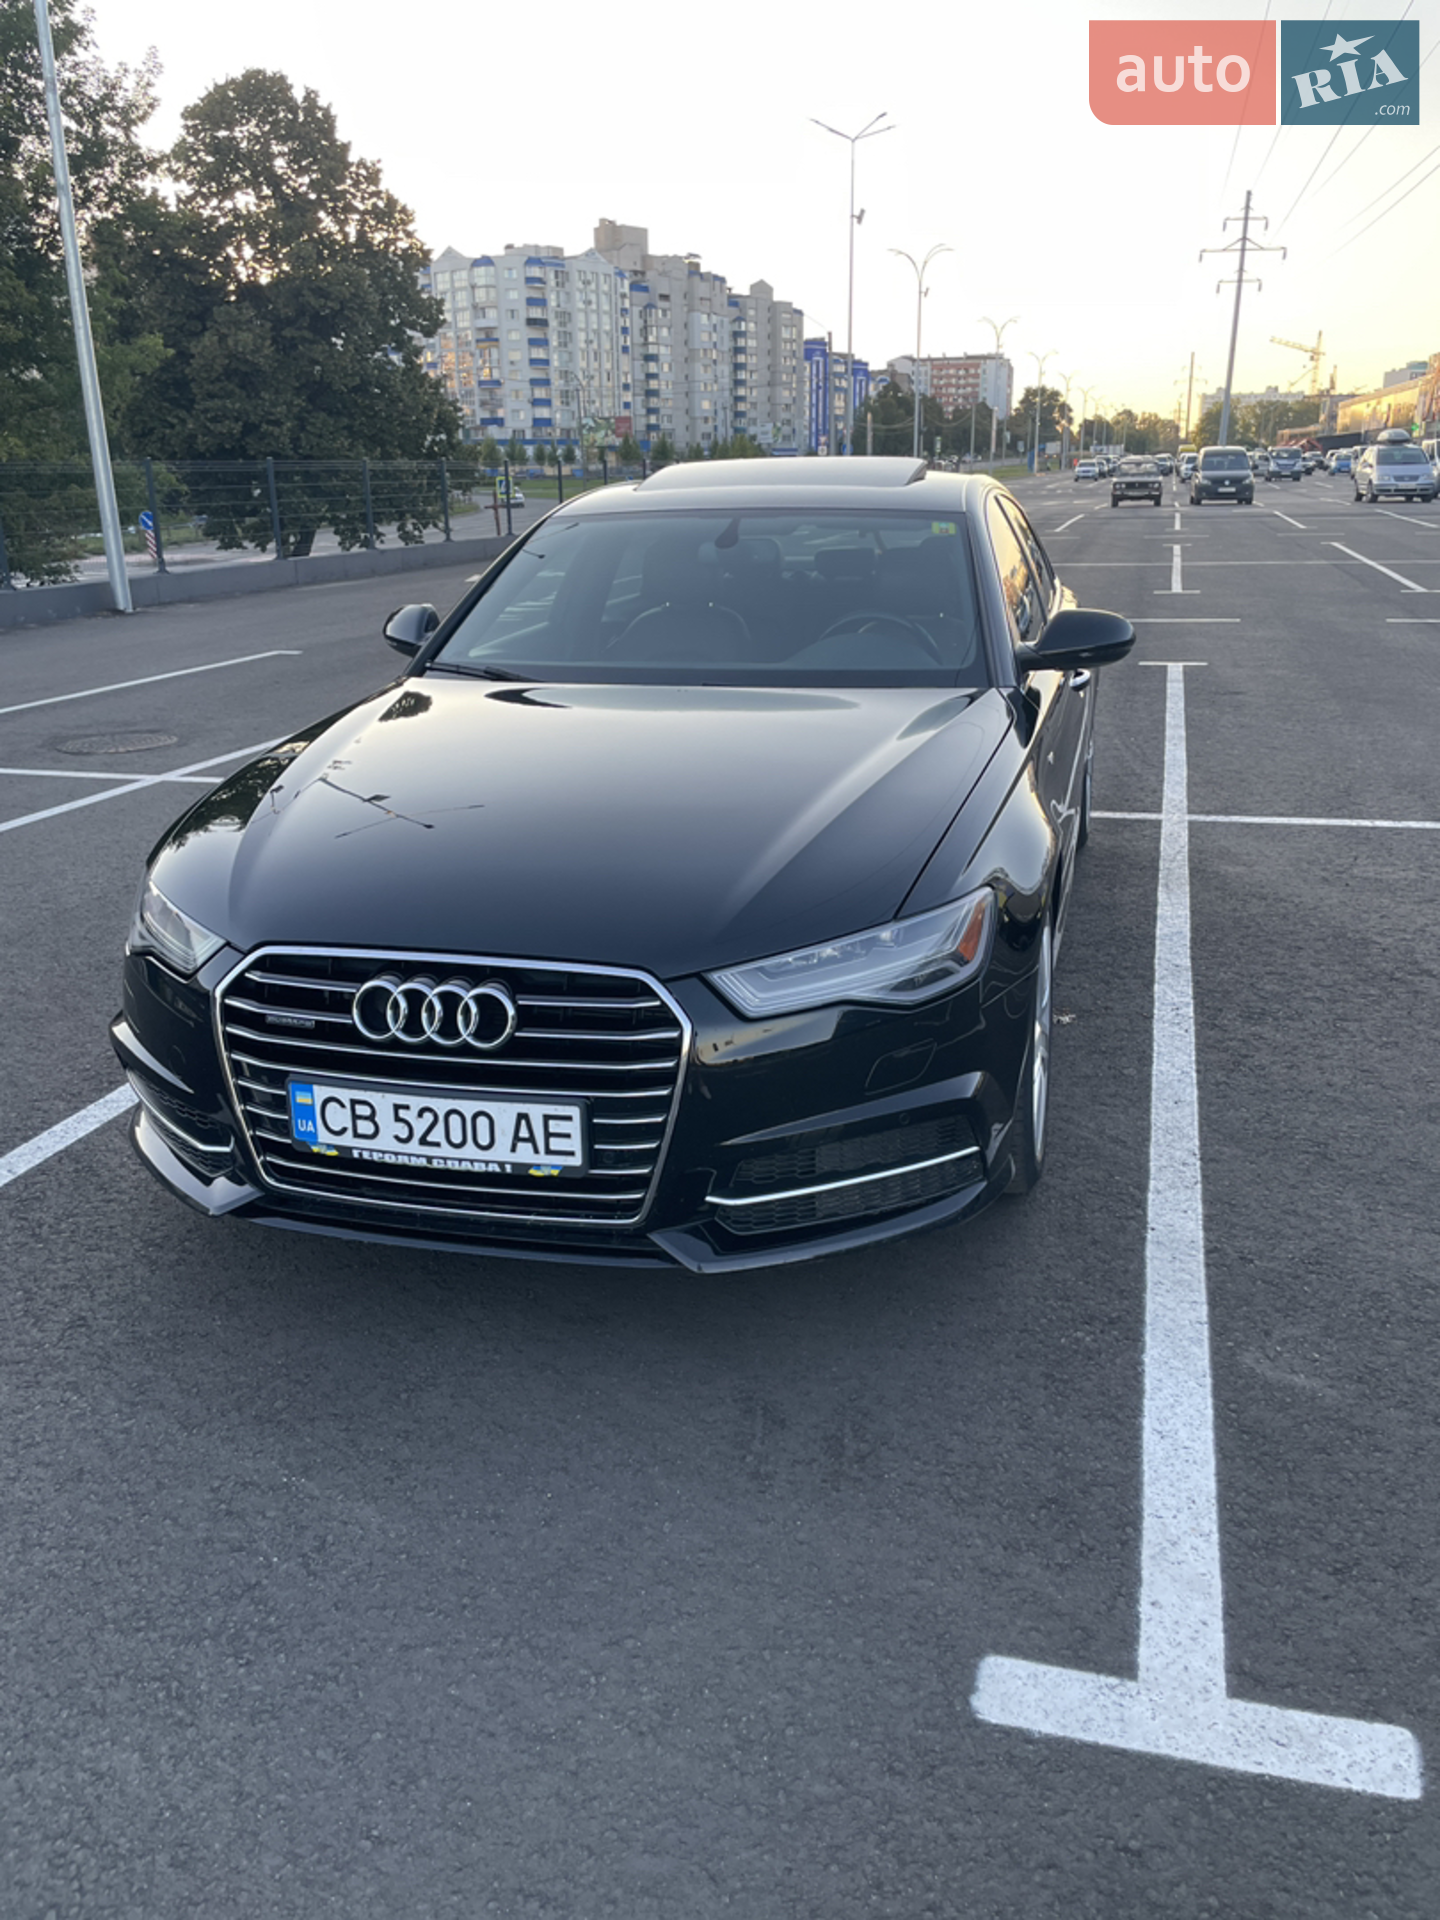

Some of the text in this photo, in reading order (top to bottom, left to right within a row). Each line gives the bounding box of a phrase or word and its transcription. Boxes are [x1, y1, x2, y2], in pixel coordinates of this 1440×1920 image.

[297, 1118, 316, 1134] UA
[320, 1095, 576, 1158] CB 5200 AE
